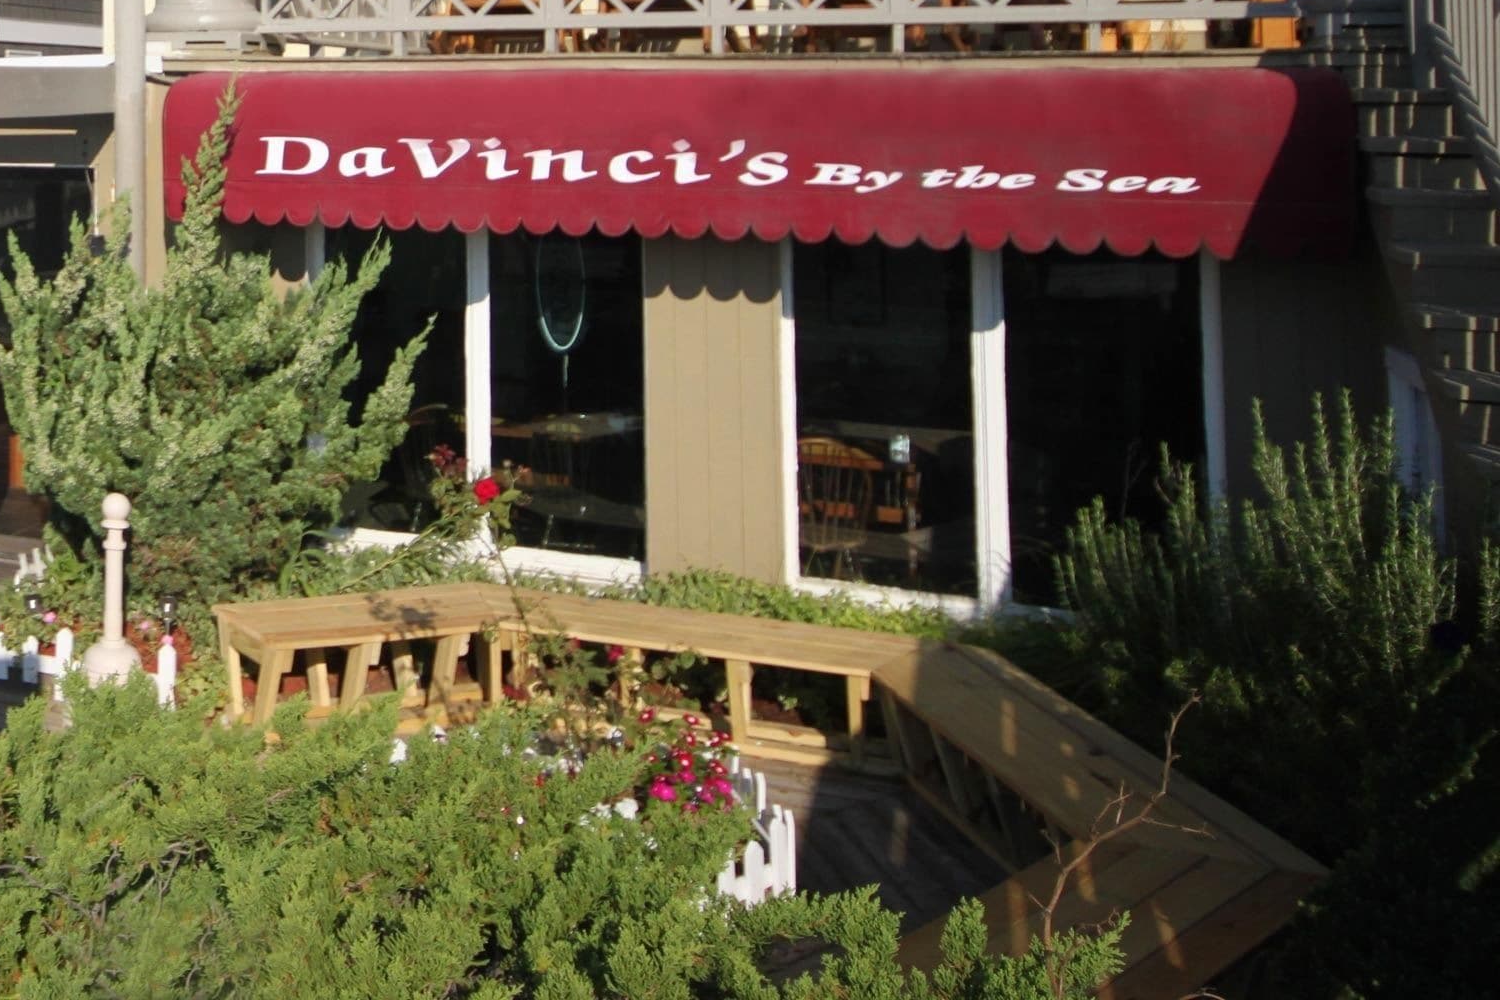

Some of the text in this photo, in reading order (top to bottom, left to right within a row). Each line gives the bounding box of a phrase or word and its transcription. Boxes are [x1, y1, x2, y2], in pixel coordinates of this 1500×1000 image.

[254, 135, 1201, 194] DaVinci's By the Sea
